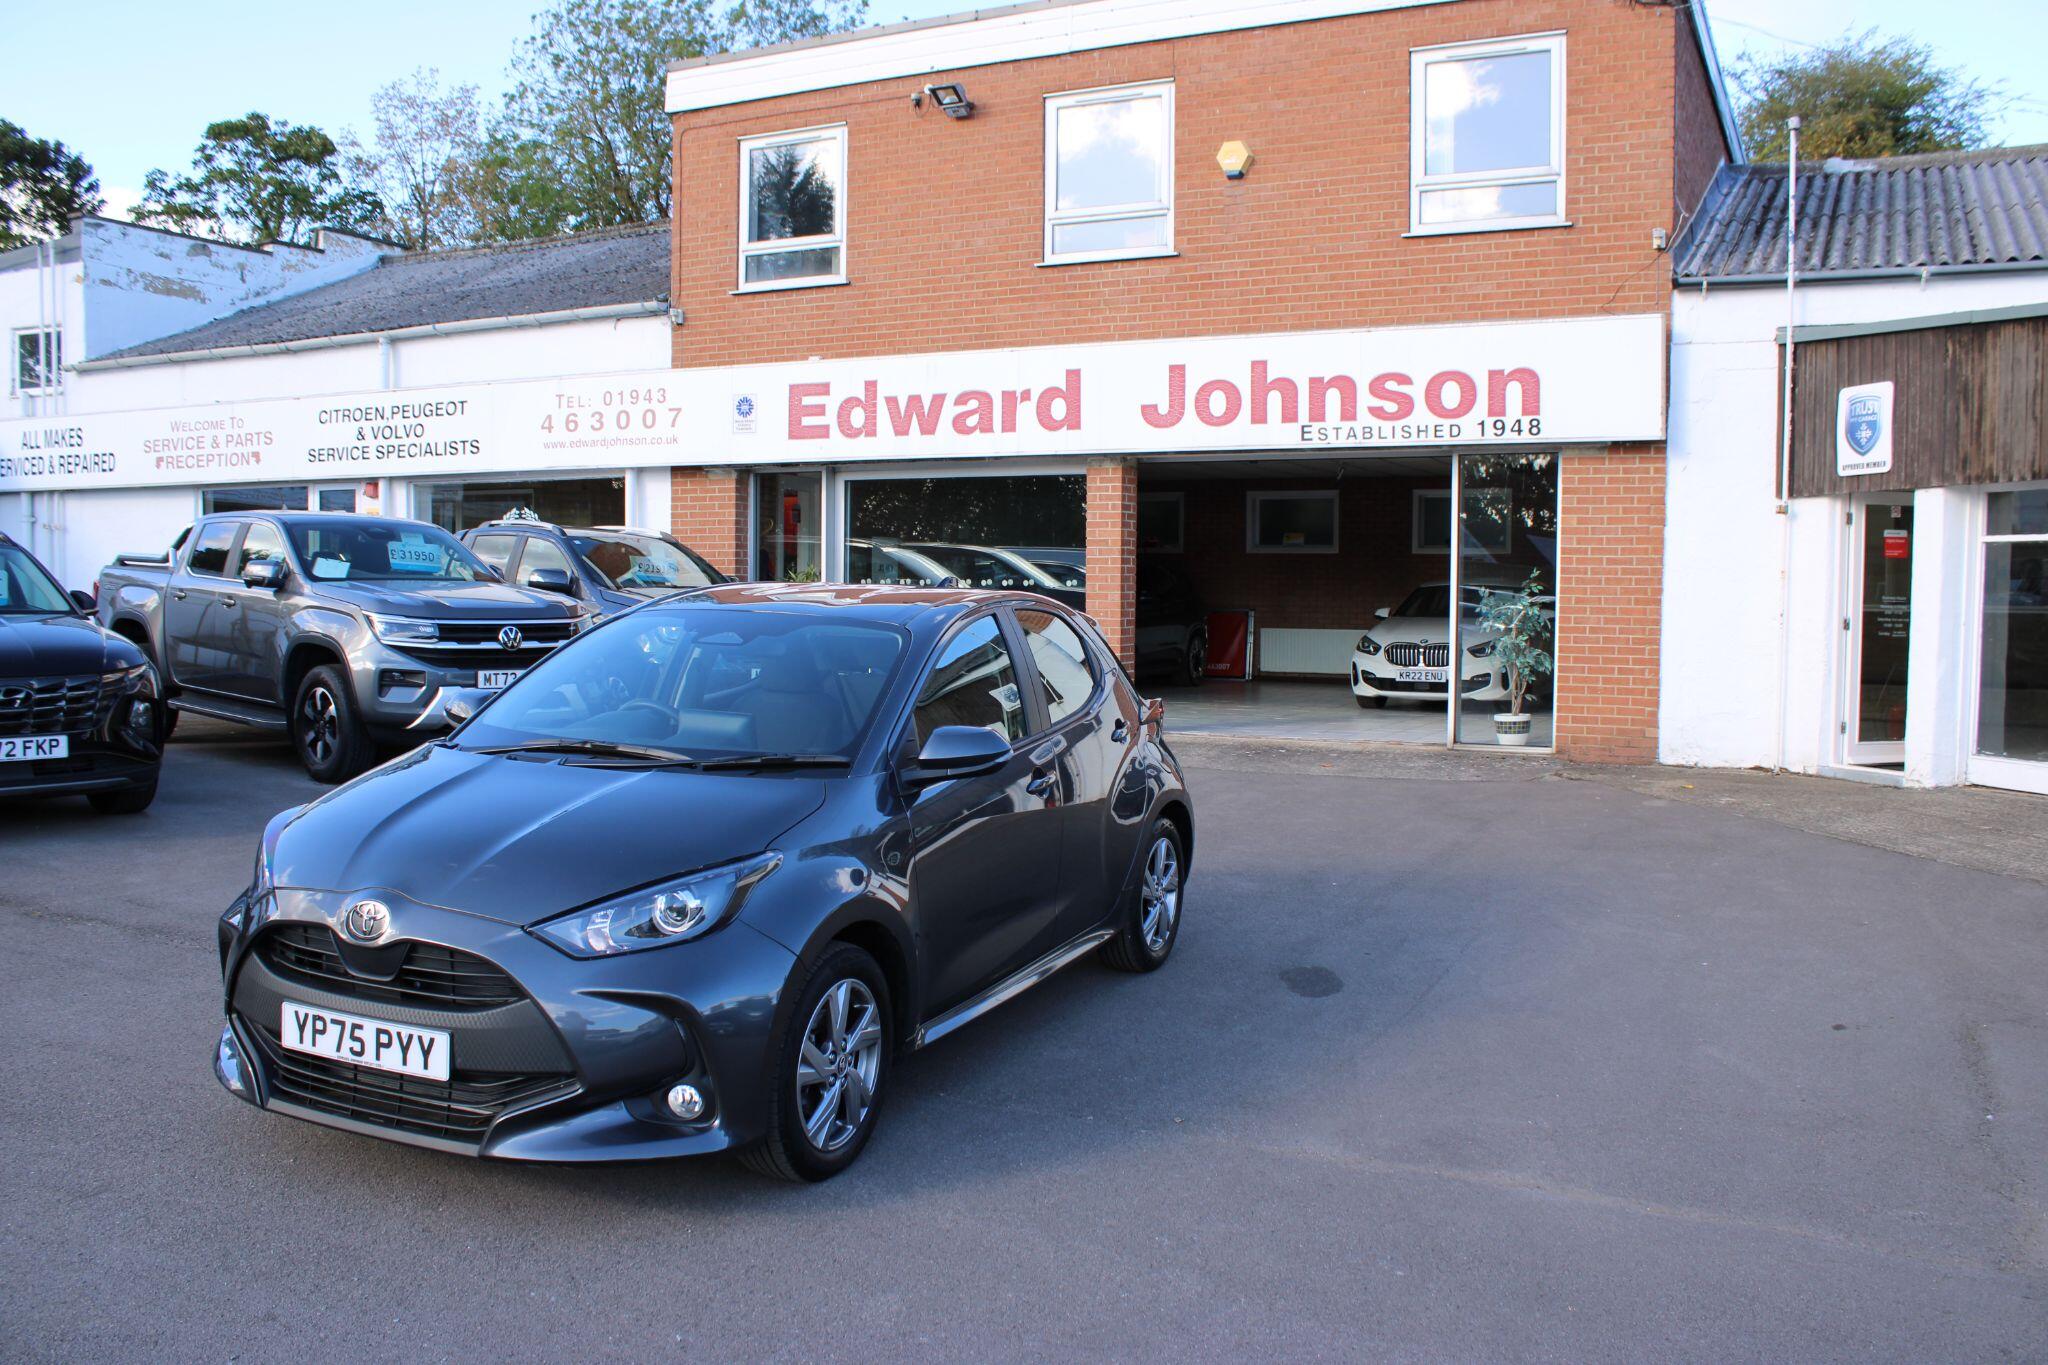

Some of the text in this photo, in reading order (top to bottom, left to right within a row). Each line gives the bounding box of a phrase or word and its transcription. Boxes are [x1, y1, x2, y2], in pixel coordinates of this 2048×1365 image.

[603, 387, 667, 406] 01943
[788, 360, 1541, 440] Edward Johnson
[1851, 400, 1878, 416] TRUST
[356, 423, 425, 441] & VOLVO
[1477, 418, 1541, 437] 1948
[21, 427, 84, 450] ALL MAKES
[143, 430, 274, 454] SERVICE & PARTS
[543, 434, 679, 450] www.edwardjohnson.co.uk
[165, 451, 250, 470] RECEPTION
[307, 439, 481, 463] SERVICE SPECIALISTS
[48, 455, 55, 475] &
[59, 452, 116, 475] REPAIRED
[1399, 671, 1443, 680] KR22 ENU
[22, 738, 60, 756] FKP
[294, 1010, 435, 1071] YP75 PYY
